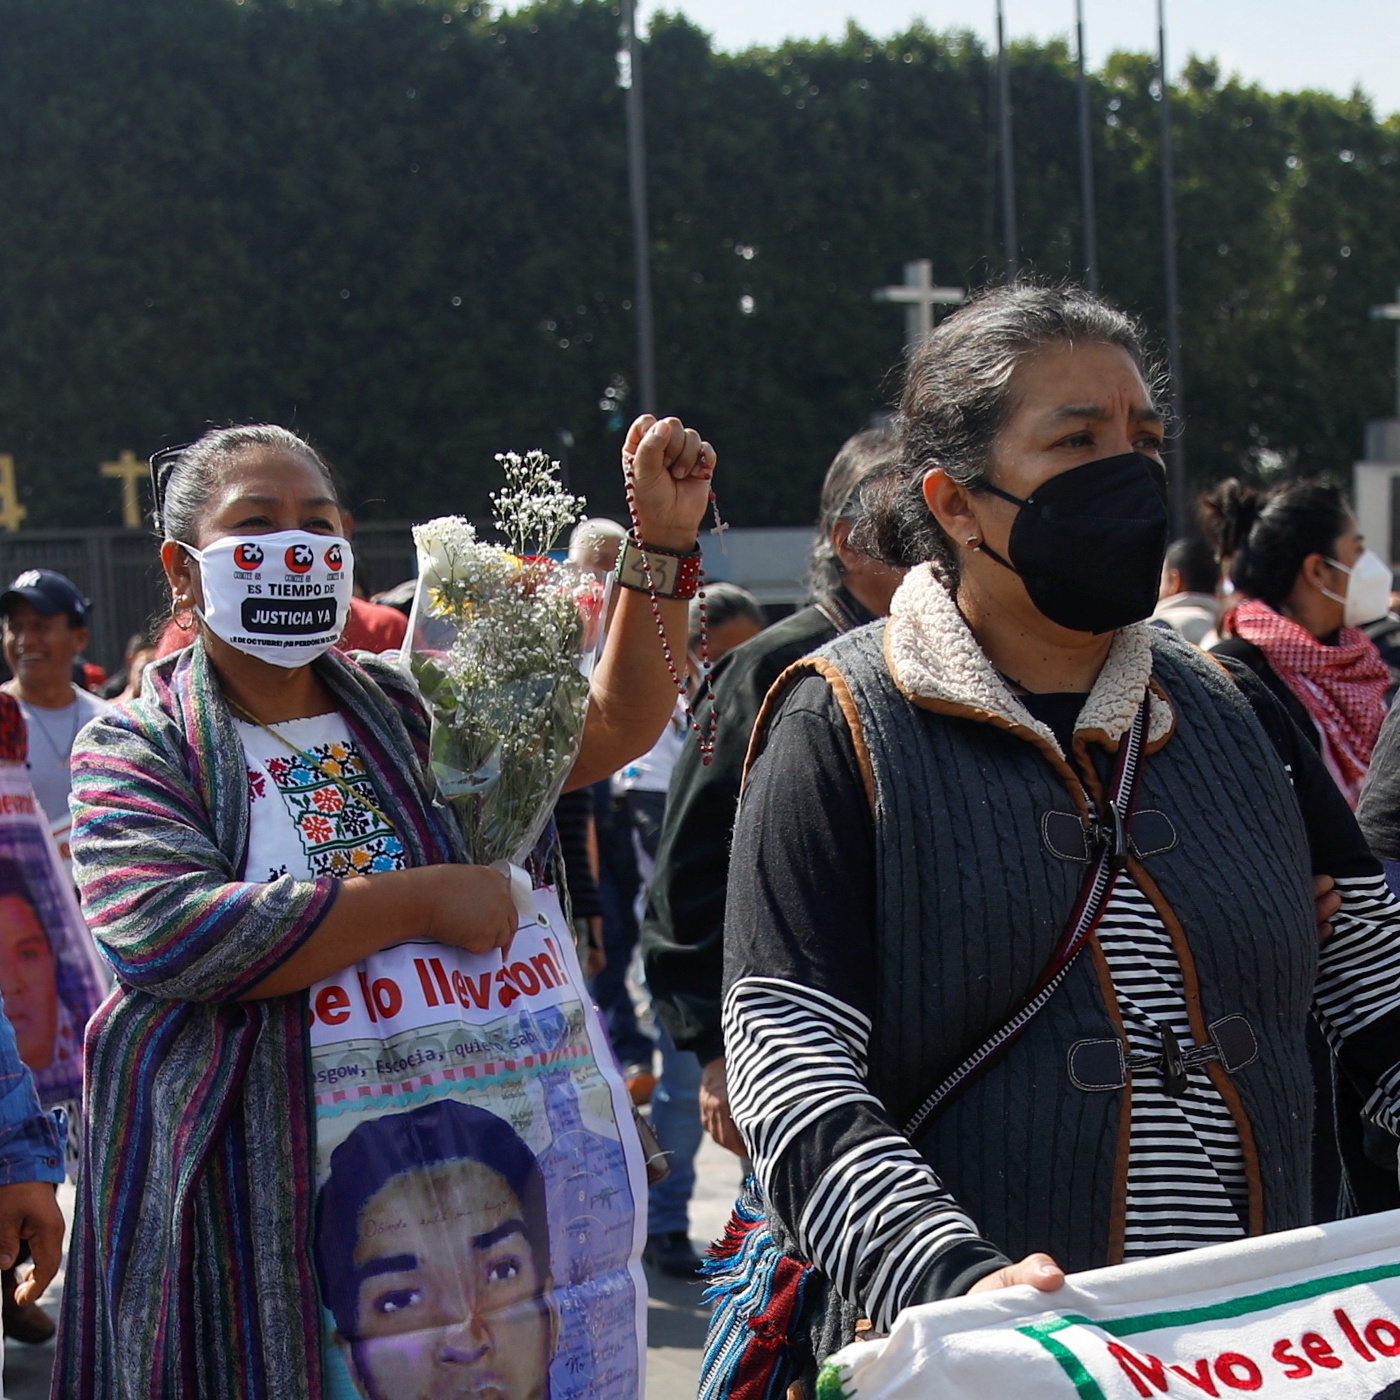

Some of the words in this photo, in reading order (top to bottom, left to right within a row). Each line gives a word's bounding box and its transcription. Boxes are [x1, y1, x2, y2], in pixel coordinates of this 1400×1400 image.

[247, 584, 262, 594] ES
[268, 584, 321, 597] TIEMPO
[324, 584, 335, 594] DE
[251, 610, 313, 625] JUSTICIA
[317, 609, 330, 623] YA
[358, 970, 403, 1023] lo
[377, 1048, 444, 1075] Escocia,
[454, 1039, 503, 1058] quiero
[1273, 1331, 1344, 1379] se
